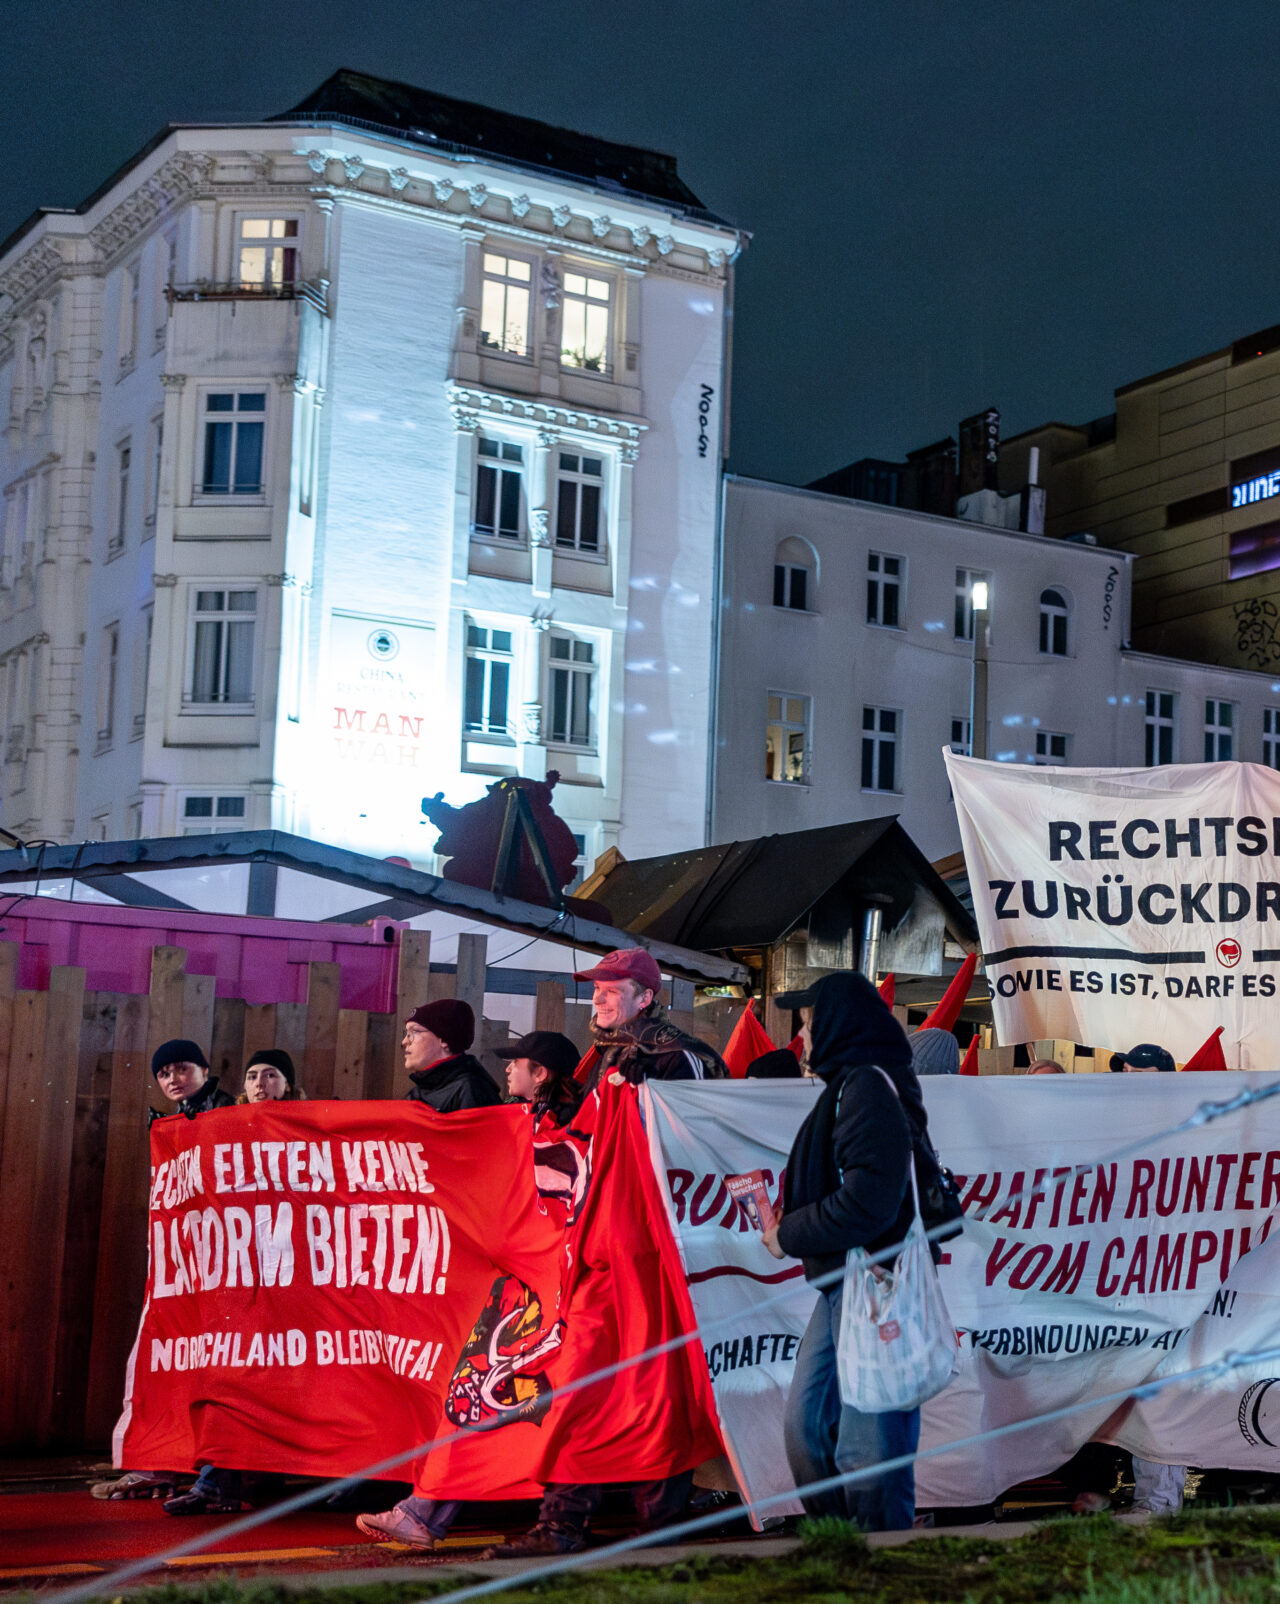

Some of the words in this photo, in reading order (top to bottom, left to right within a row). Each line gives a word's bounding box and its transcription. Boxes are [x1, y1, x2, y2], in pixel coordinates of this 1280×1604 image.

[332, 707, 425, 739] MAN
[1070, 970, 1103, 994] ES
[1110, 972, 1158, 999] IST,
[1165, 974, 1234, 999] DARF
[1242, 974, 1276, 997] ES
[214, 1140, 336, 1194] ELITEN
[341, 1140, 435, 1194] KEINE
[306, 1203, 451, 1295] BIETEN!
[985, 1237, 1091, 1295] VOM
[704, 1333, 804, 1379] CHAFTE
